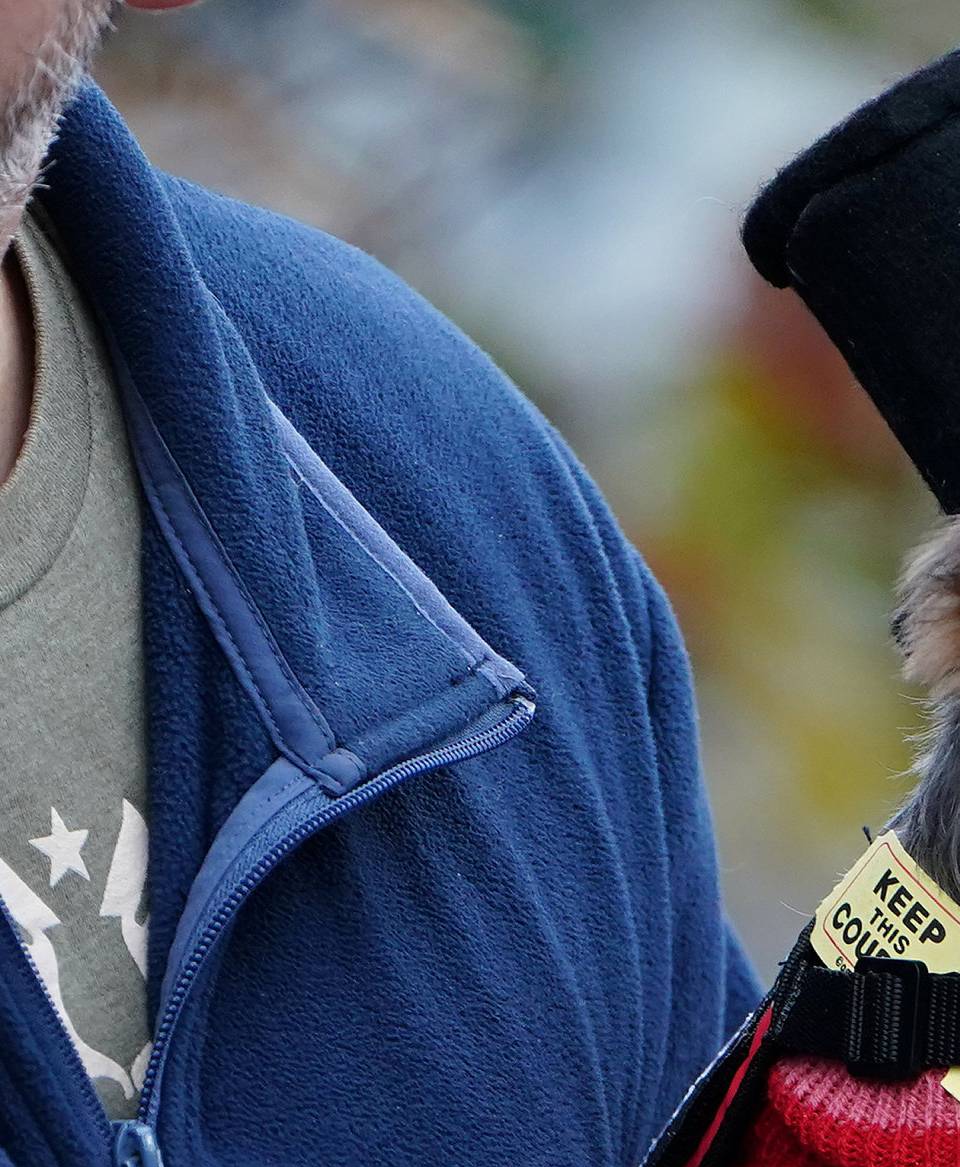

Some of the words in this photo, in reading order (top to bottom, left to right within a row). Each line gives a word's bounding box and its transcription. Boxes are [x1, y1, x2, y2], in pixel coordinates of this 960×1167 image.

[832, 902, 891, 959] COU
[869, 907, 910, 954] THIS
[873, 868, 946, 944] KEEP
